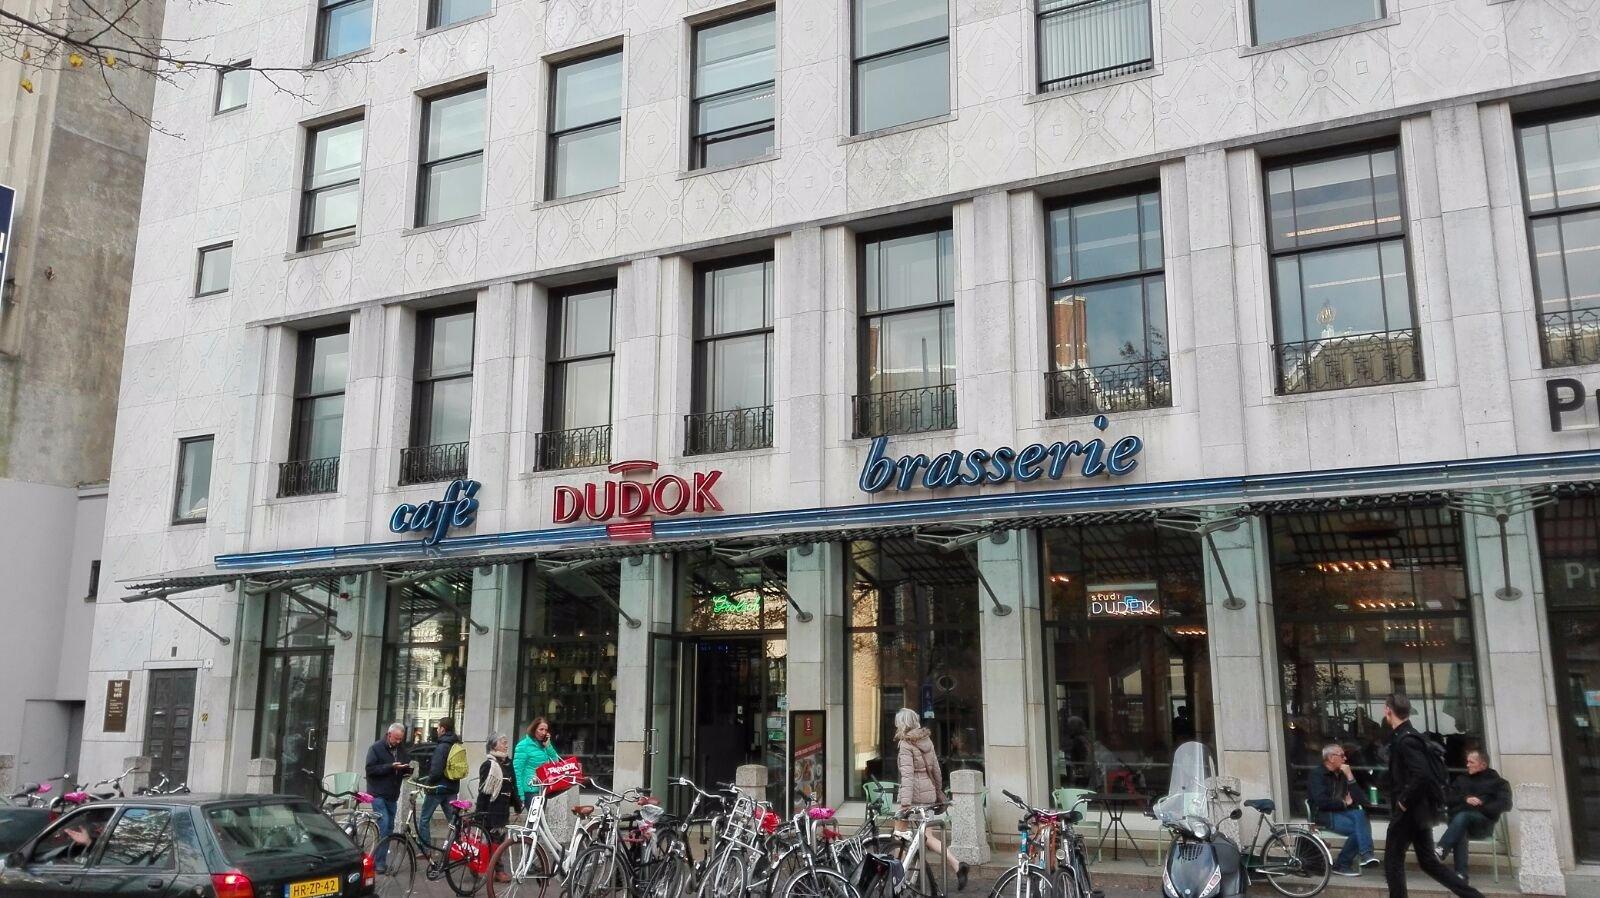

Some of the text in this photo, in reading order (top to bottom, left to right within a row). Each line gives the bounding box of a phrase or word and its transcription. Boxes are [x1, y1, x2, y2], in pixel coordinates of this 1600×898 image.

[1546, 378, 1600, 432] P
[859, 415, 1143, 493] brasserie
[389, 479, 481, 546] café
[553, 470, 724, 523] DUDOK
[293, 879, 336, 898] HR-ZP-42
